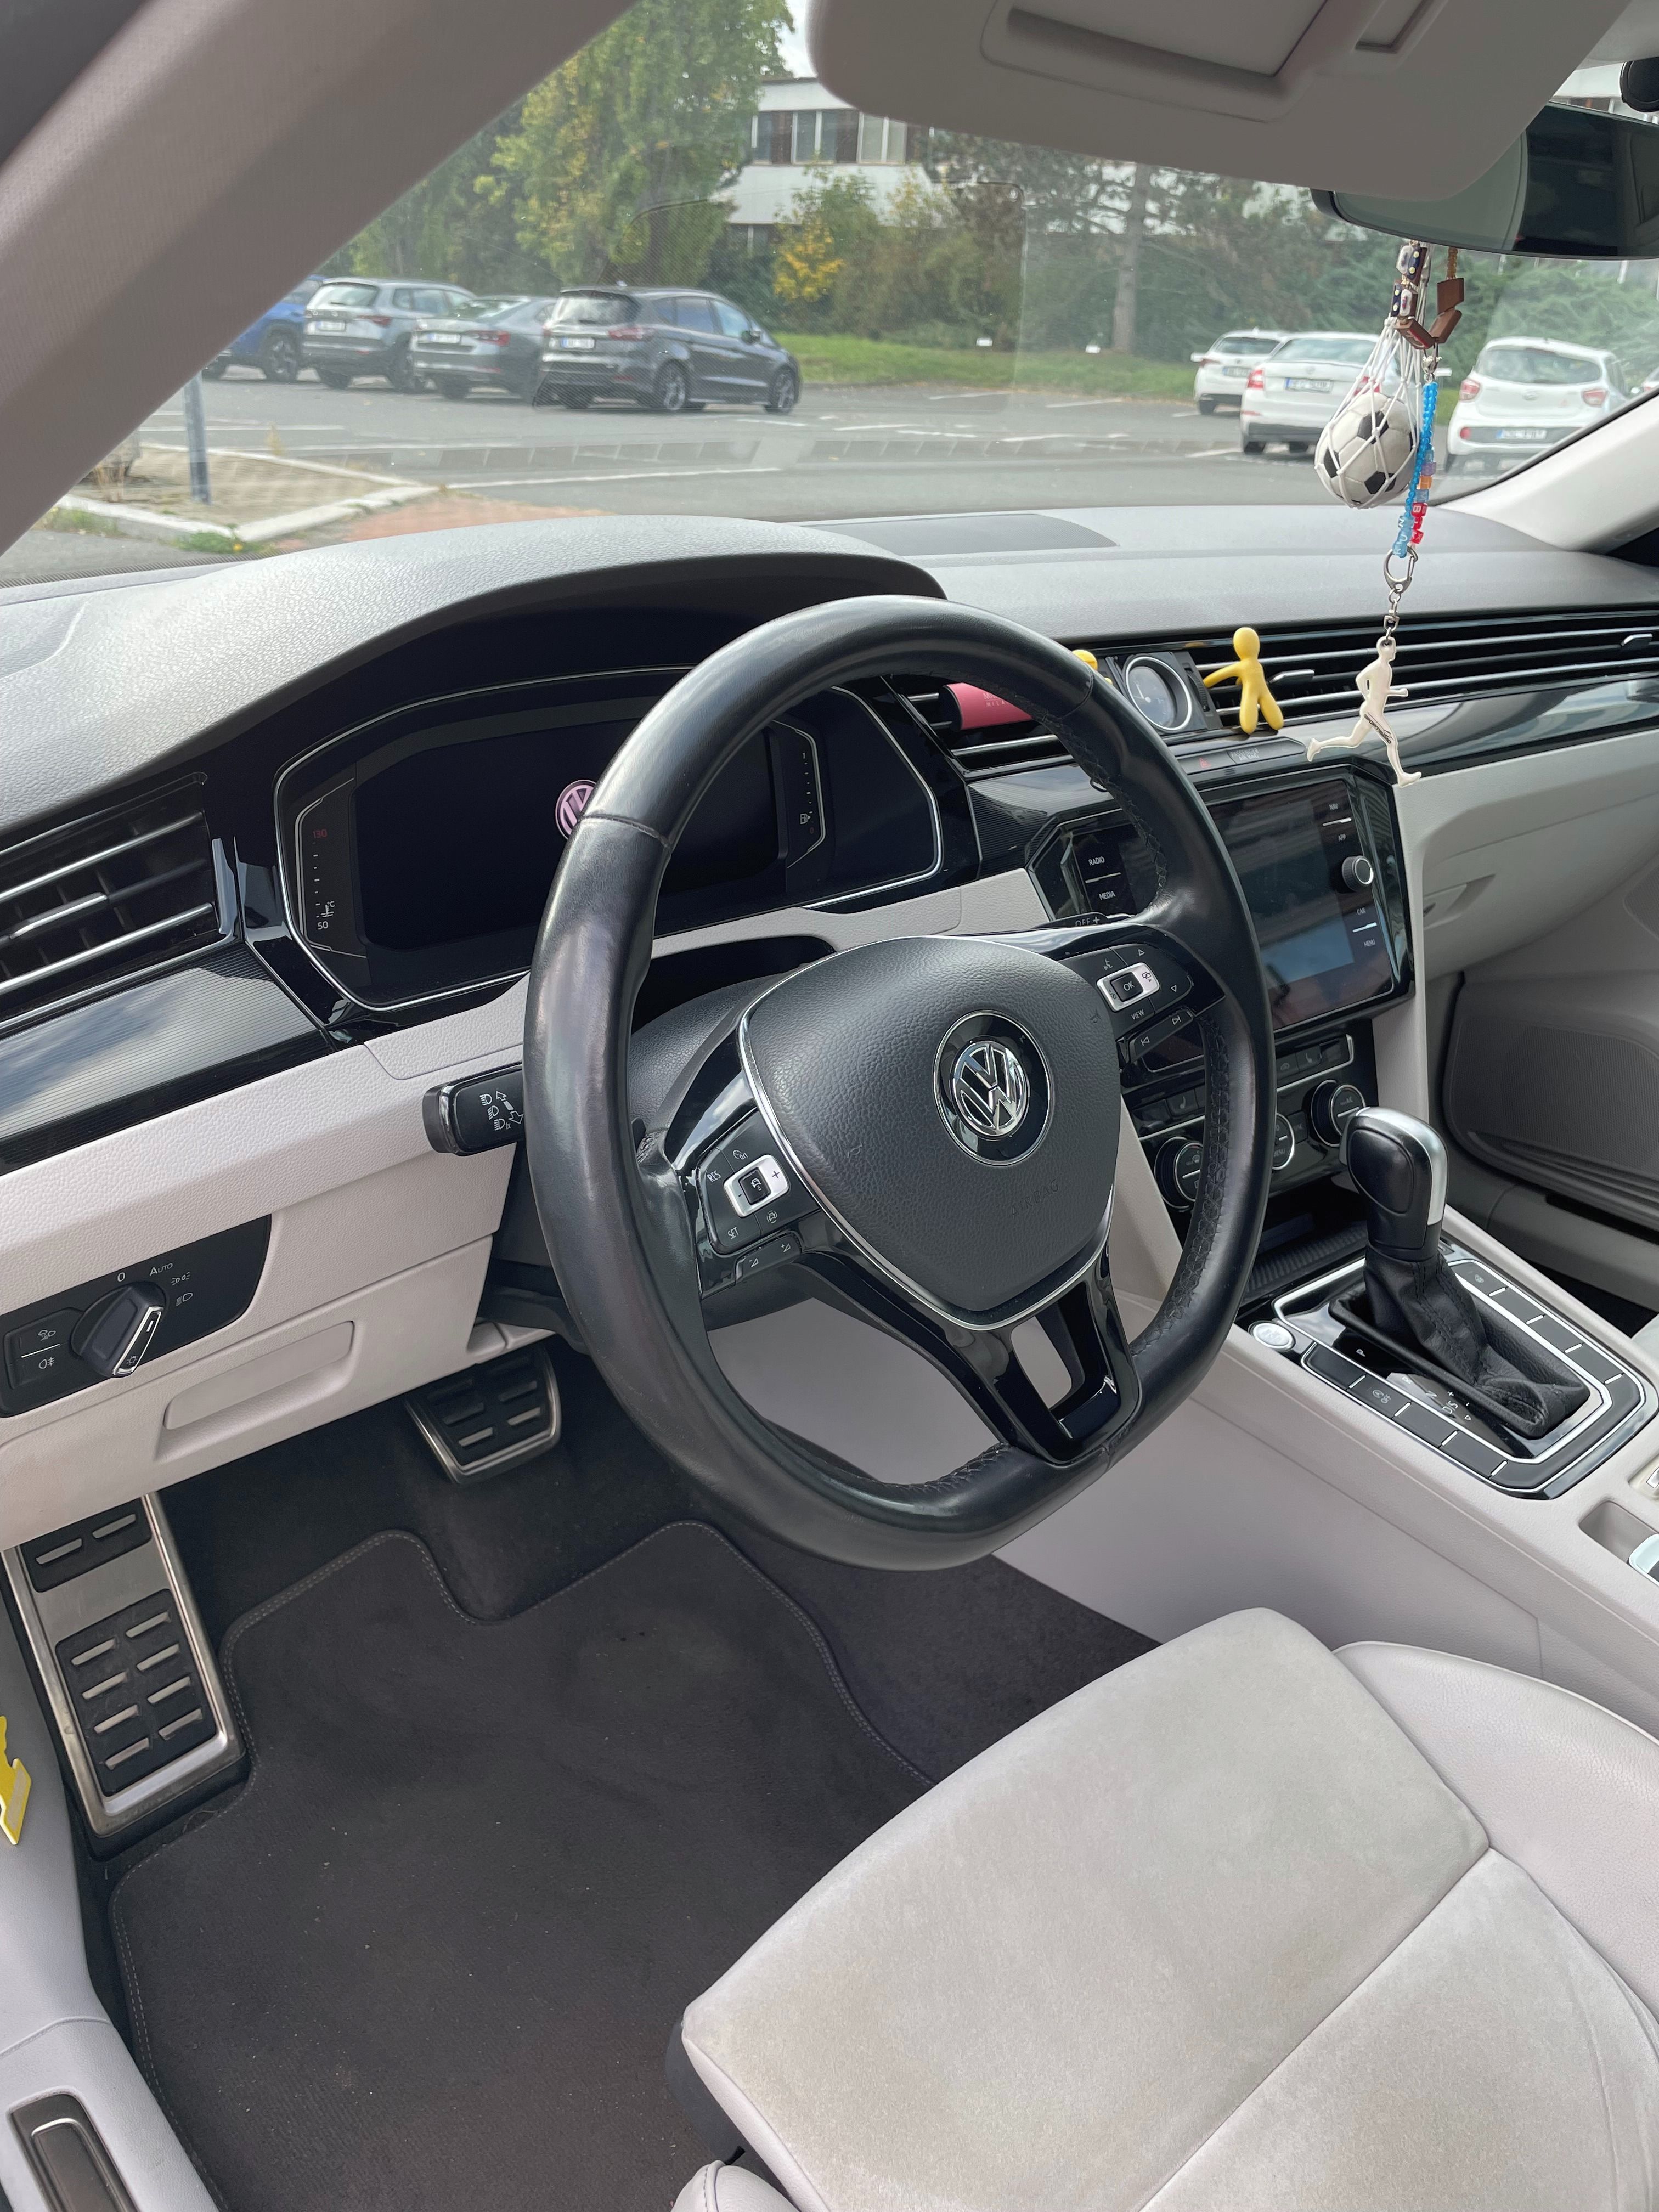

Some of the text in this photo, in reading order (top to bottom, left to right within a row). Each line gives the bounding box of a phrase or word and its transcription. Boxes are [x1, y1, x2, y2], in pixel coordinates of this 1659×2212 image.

[312, 829, 328, 839] 130
[1088, 856, 1105, 866] RADIO
[1099, 890, 1116, 900] MEDIA
[1357, 907, 1366, 916] CAR
[317, 921, 329, 930] 50
[1363, 938, 1376, 947] MENU
[1123, 980, 1135, 991] OK
[1131, 1009, 1145, 1020] VIEW
[707, 1170, 721, 1183] RES
[727, 1226, 739, 1240] SET
